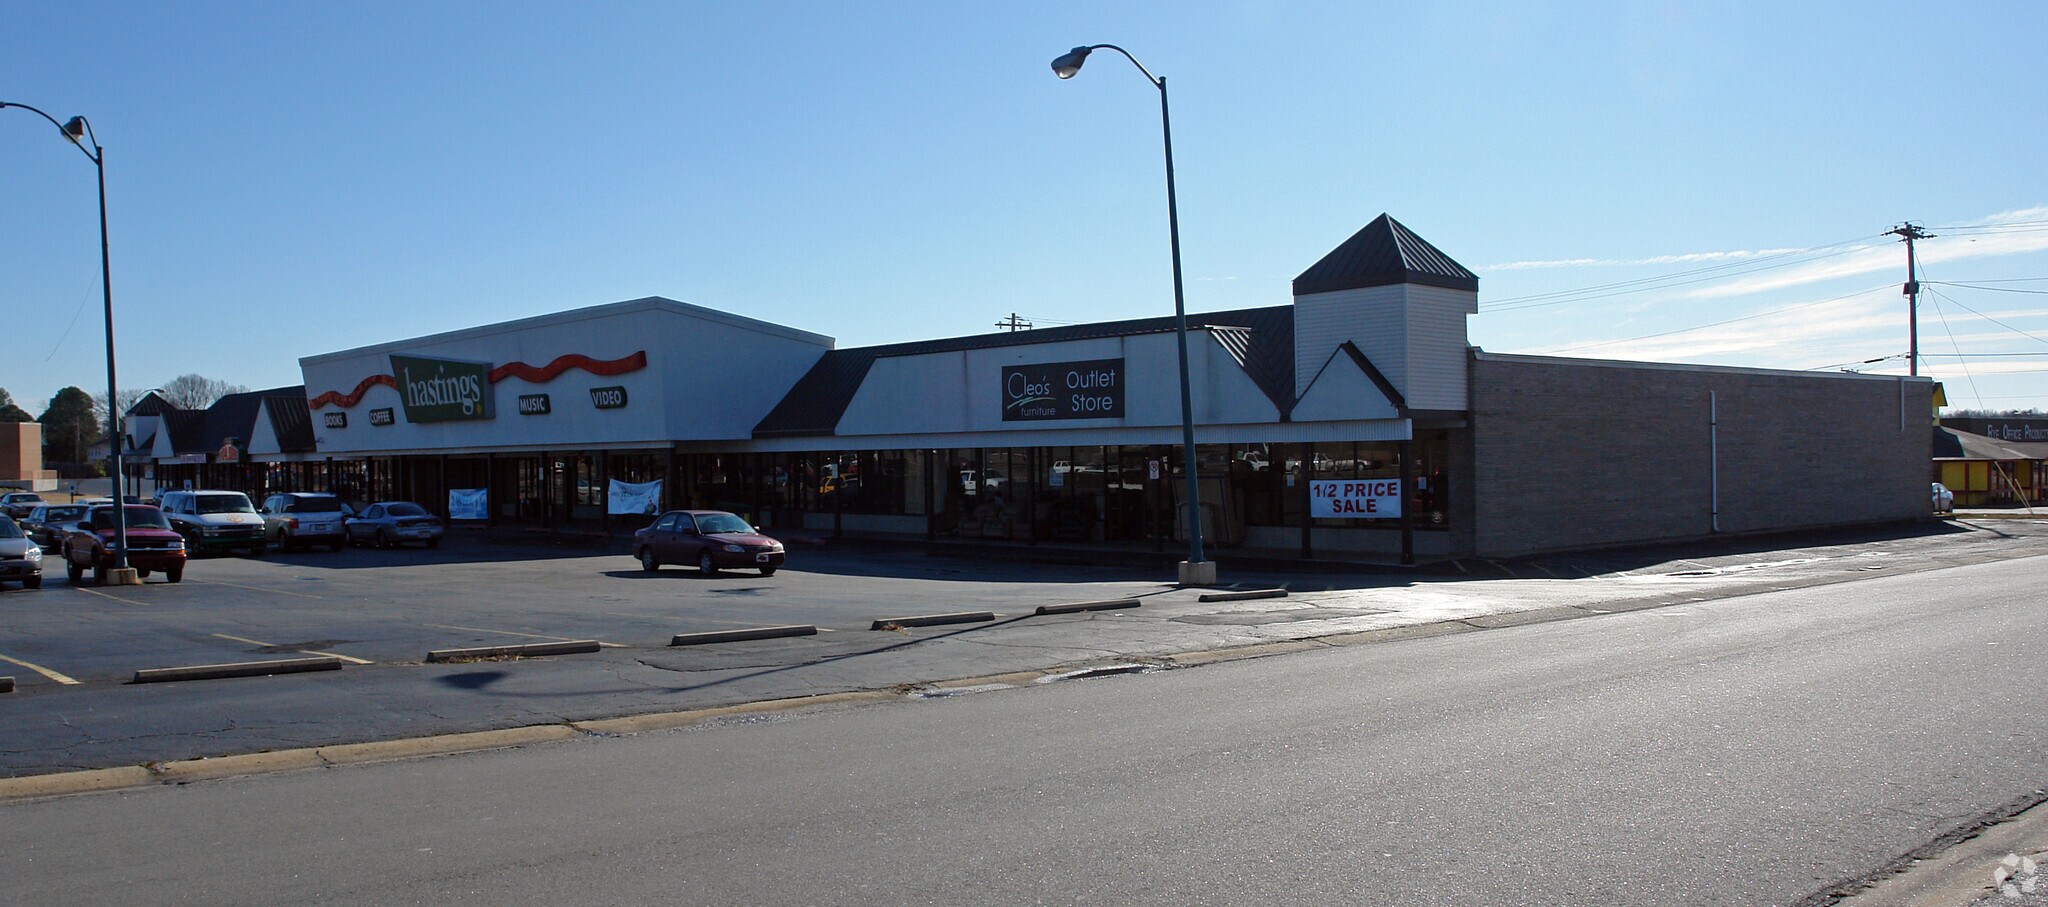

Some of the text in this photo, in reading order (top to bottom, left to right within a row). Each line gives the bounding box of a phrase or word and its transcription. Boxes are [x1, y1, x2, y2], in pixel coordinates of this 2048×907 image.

[1008, 372, 1050, 398] Cleo's
[1066, 369, 1116, 389] Outlet
[404, 364, 480, 415] hastings
[520, 398, 545, 412] MUSIC
[592, 390, 621, 405] VIDEO
[1072, 394, 1113, 412] Store
[370, 410, 391, 424] COFFEE
[1021, 407, 1056, 416] furniture
[325, 414, 344, 427] BOOKS
[2003, 424, 2022, 440] OFFICE
[1313, 482, 1398, 498] 1/2 PRICE
[1332, 499, 1377, 513] SALE
